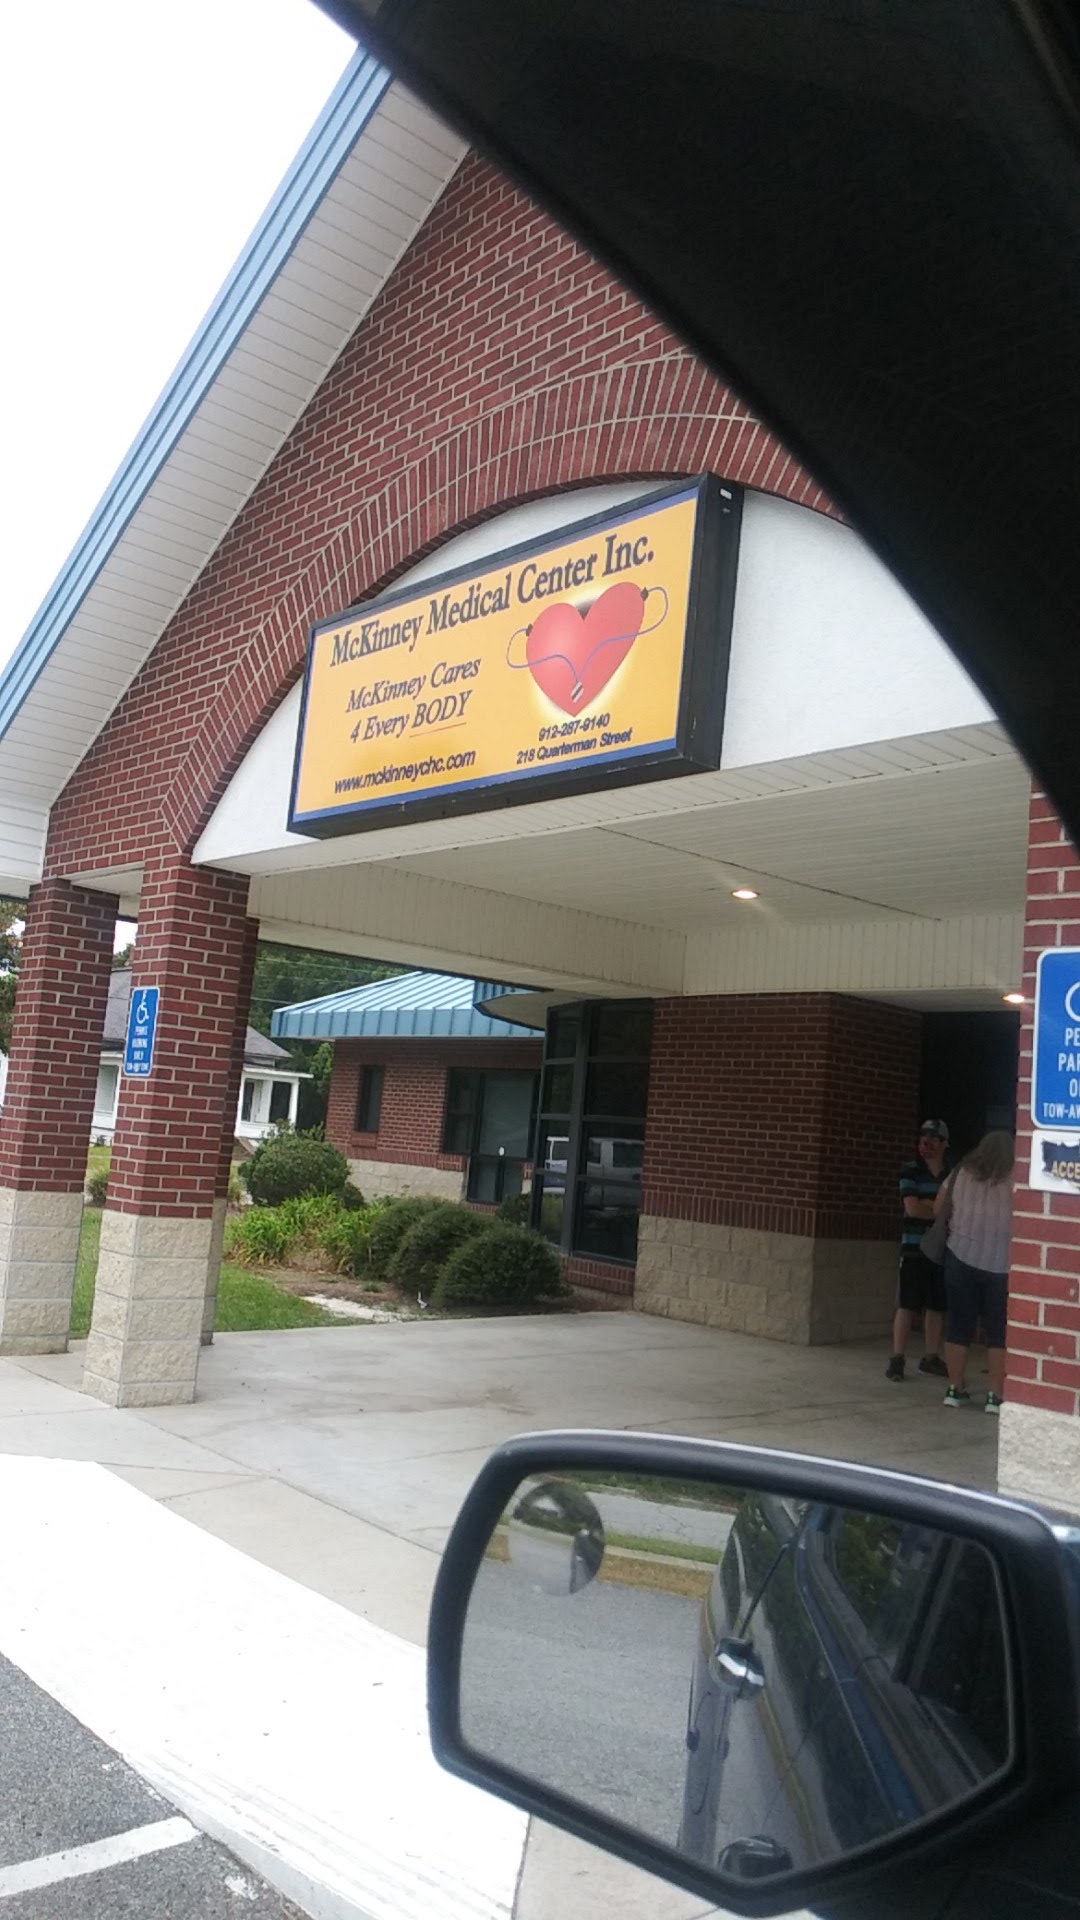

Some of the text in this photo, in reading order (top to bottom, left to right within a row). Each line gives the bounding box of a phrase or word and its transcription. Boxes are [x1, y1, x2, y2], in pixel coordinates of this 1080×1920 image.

[330, 534, 655, 668] McKinney Medical Center Inc.
[346, 657, 481, 713] McKinney Cares
[350, 690, 471, 743] 4 Every BODY
[538, 713, 611, 742] 912-287-9140
[536, 737, 597, 760] Quarterman
[599, 727, 633, 748] Street
[334, 750, 477, 794] www.mckinneychc.com
